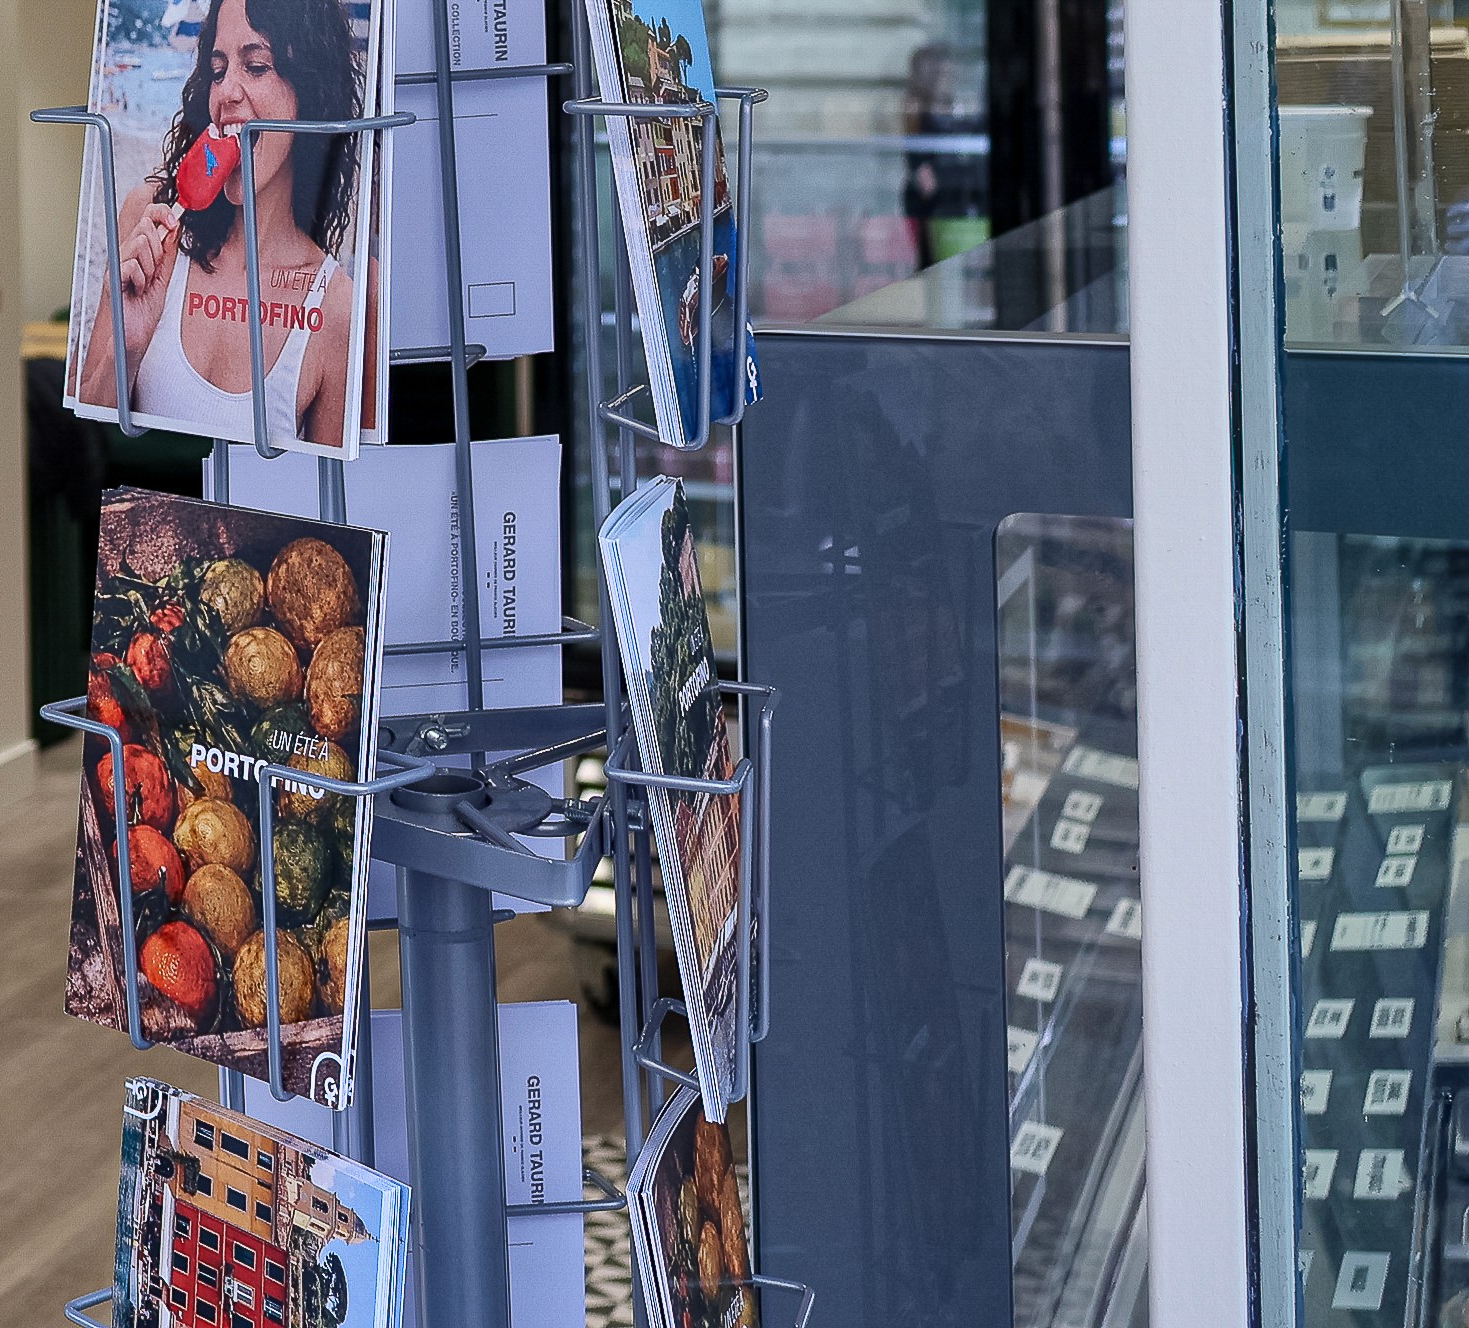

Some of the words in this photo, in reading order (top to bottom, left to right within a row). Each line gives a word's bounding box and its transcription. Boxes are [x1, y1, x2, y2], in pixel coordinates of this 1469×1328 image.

[451, 3, 462, 67] COLLECTION
[493, 0, 508, 62] TAURIN
[270, 268, 291, 289] UN
[292, 267, 317, 293] ÉTÉ
[317, 269, 328, 294] À
[503, 511, 516, 582] GERARD
[503, 585, 516, 638] TAURI
[272, 729, 293, 752] UN
[293, 729, 319, 760] ÉTÉ
[318, 736, 330, 762] À
[526, 1075, 543, 1146] GERARD
